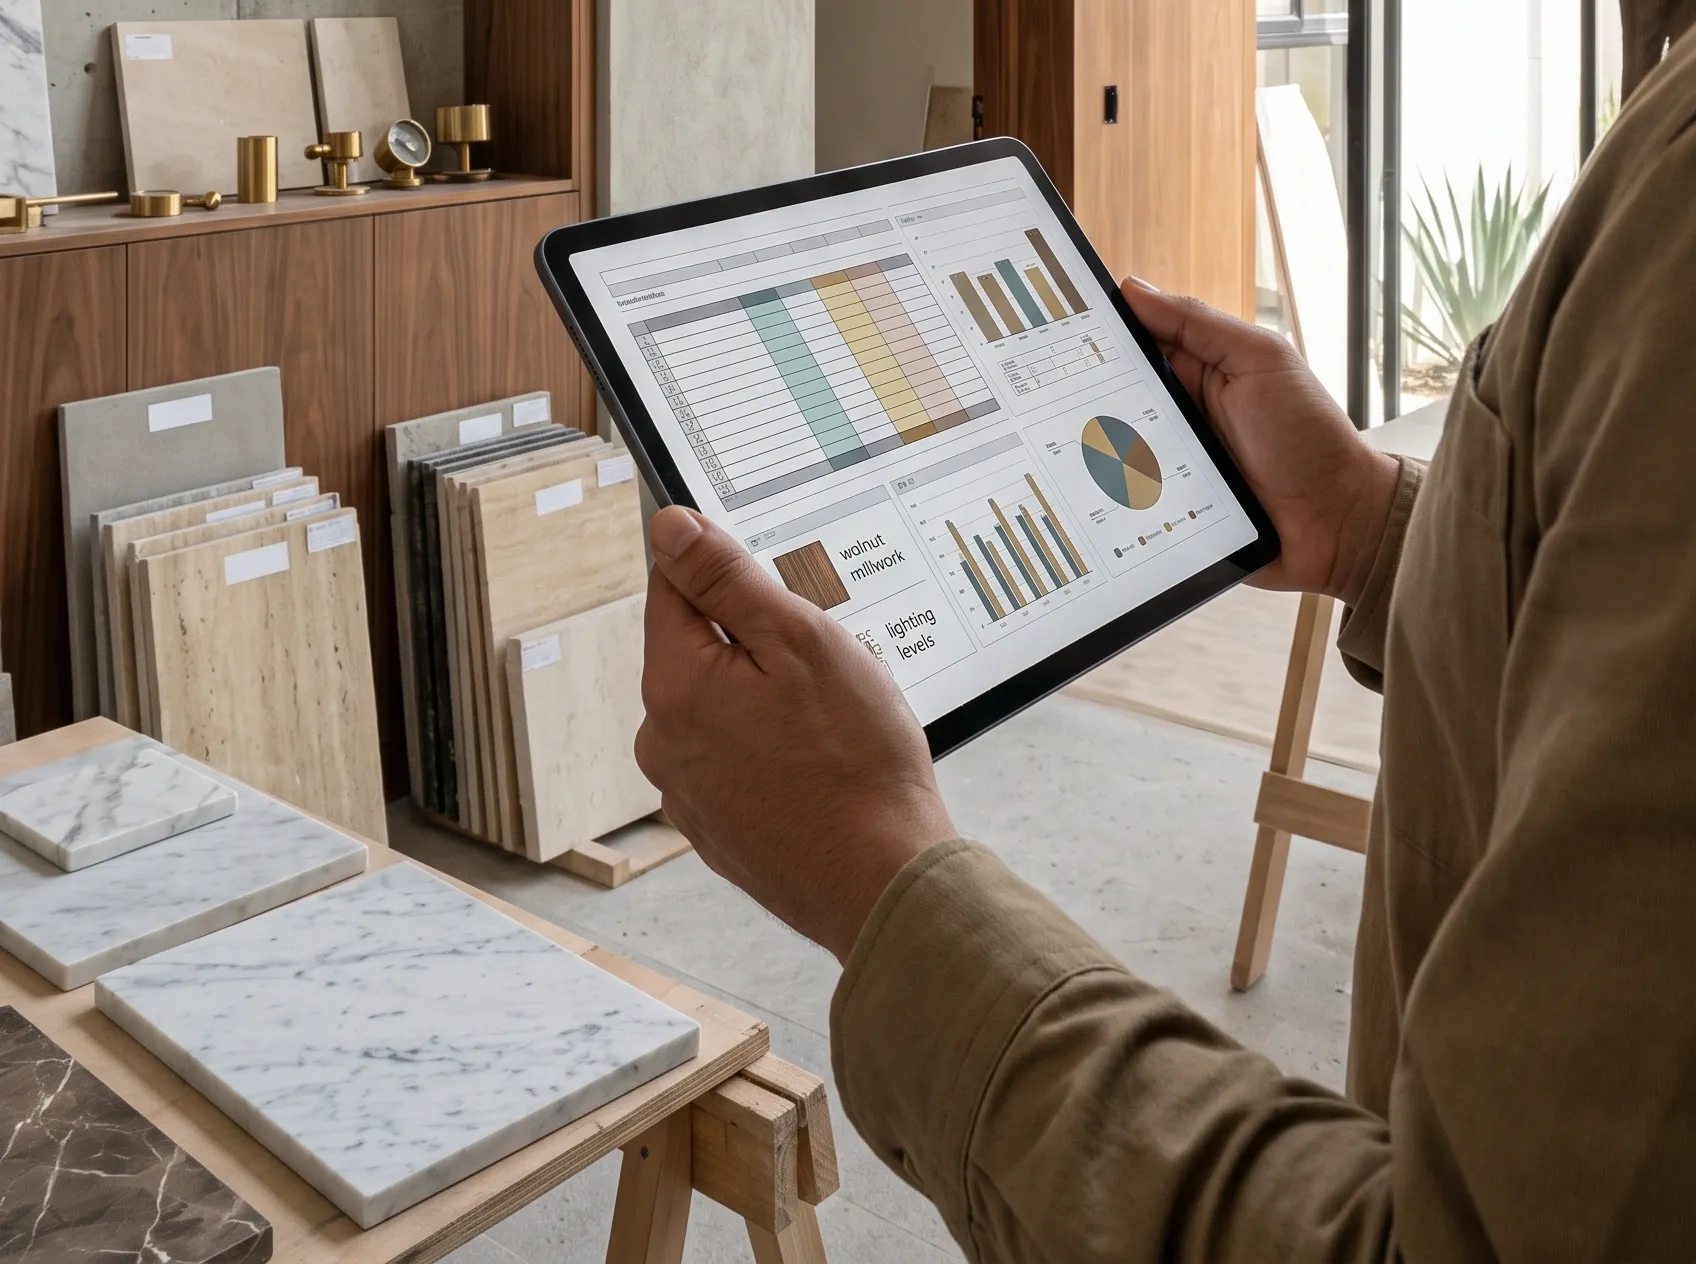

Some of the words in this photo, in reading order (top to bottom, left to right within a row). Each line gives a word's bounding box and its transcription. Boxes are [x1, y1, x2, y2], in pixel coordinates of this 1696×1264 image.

[839, 533, 886, 561] walnut
[884, 609, 937, 639] lighting
[896, 634, 936, 661] levels
